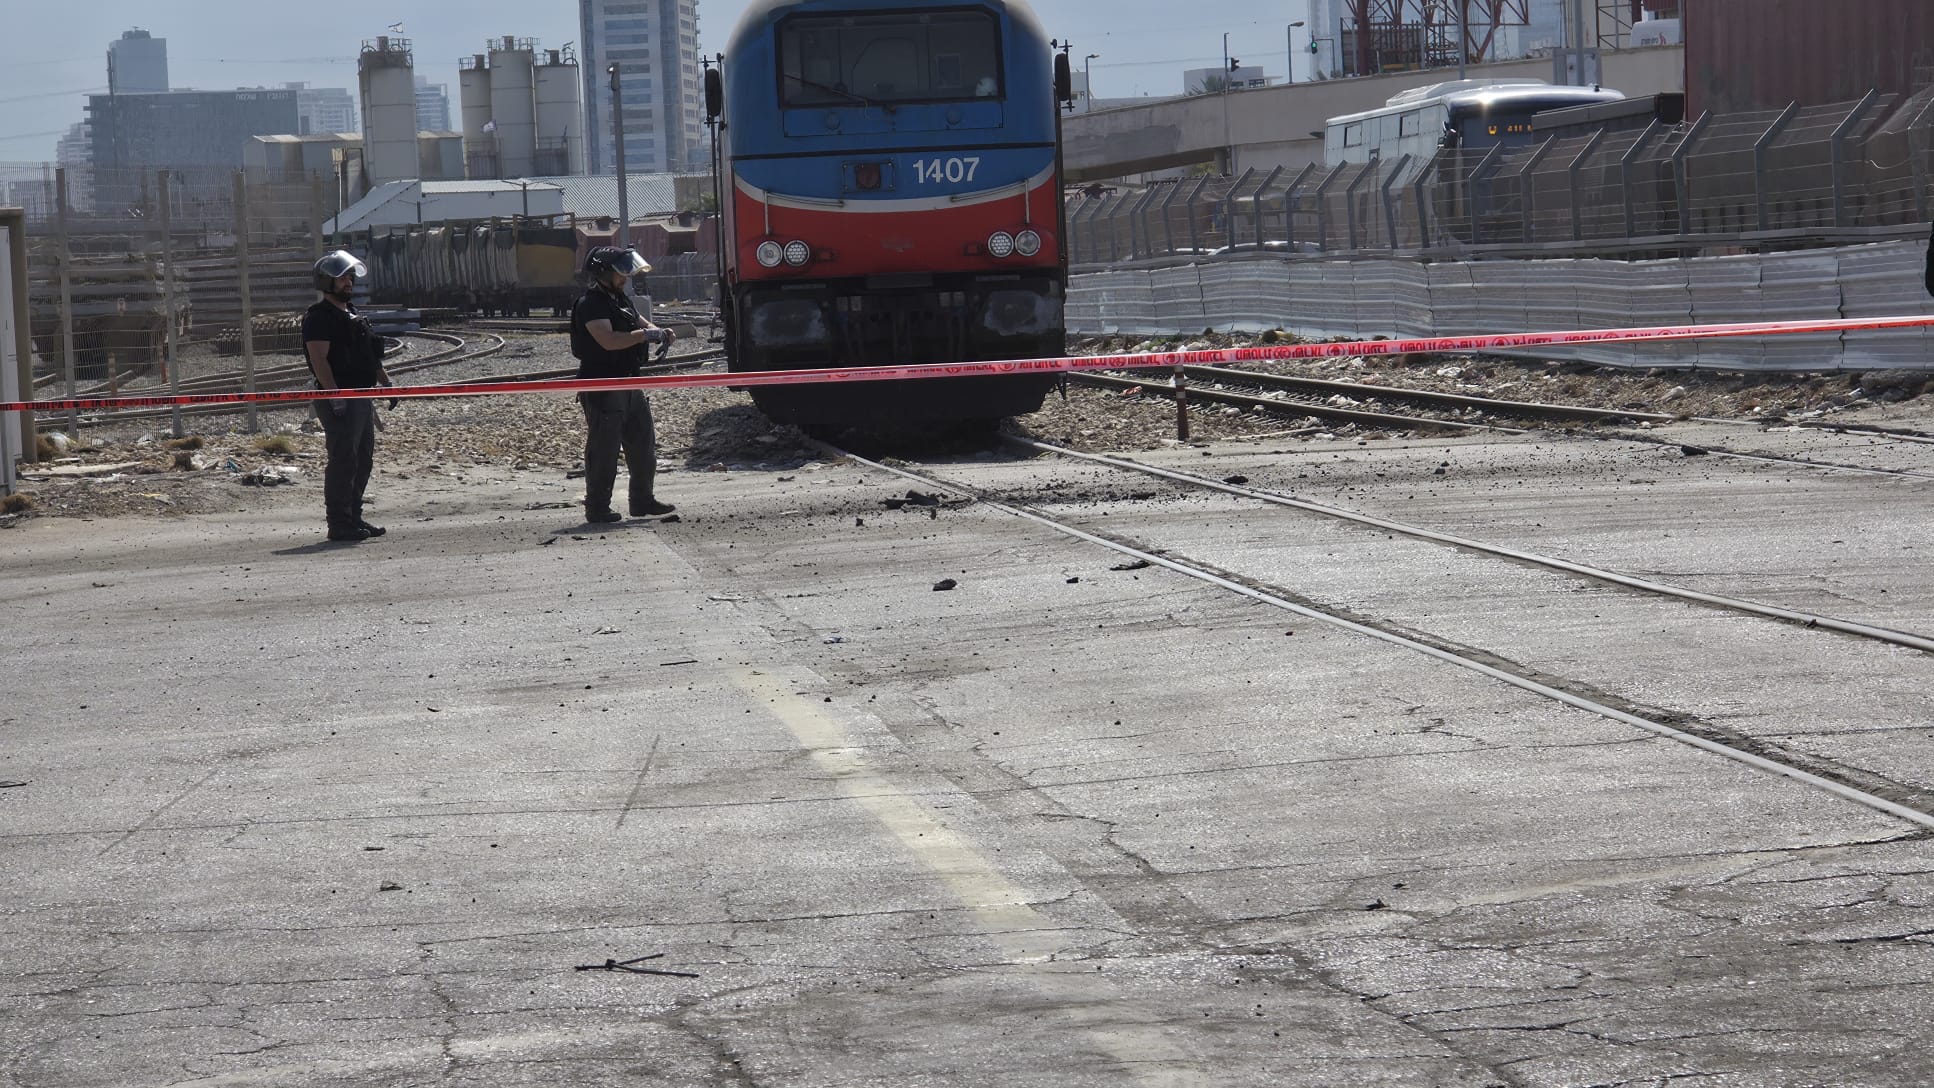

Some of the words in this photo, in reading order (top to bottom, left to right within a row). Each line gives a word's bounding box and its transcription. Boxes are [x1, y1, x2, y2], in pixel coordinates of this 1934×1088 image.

[912, 156, 980, 184] 1407
[1235, 347, 1272, 360] משטרת
[1293, 344, 1325, 358] ישראל
